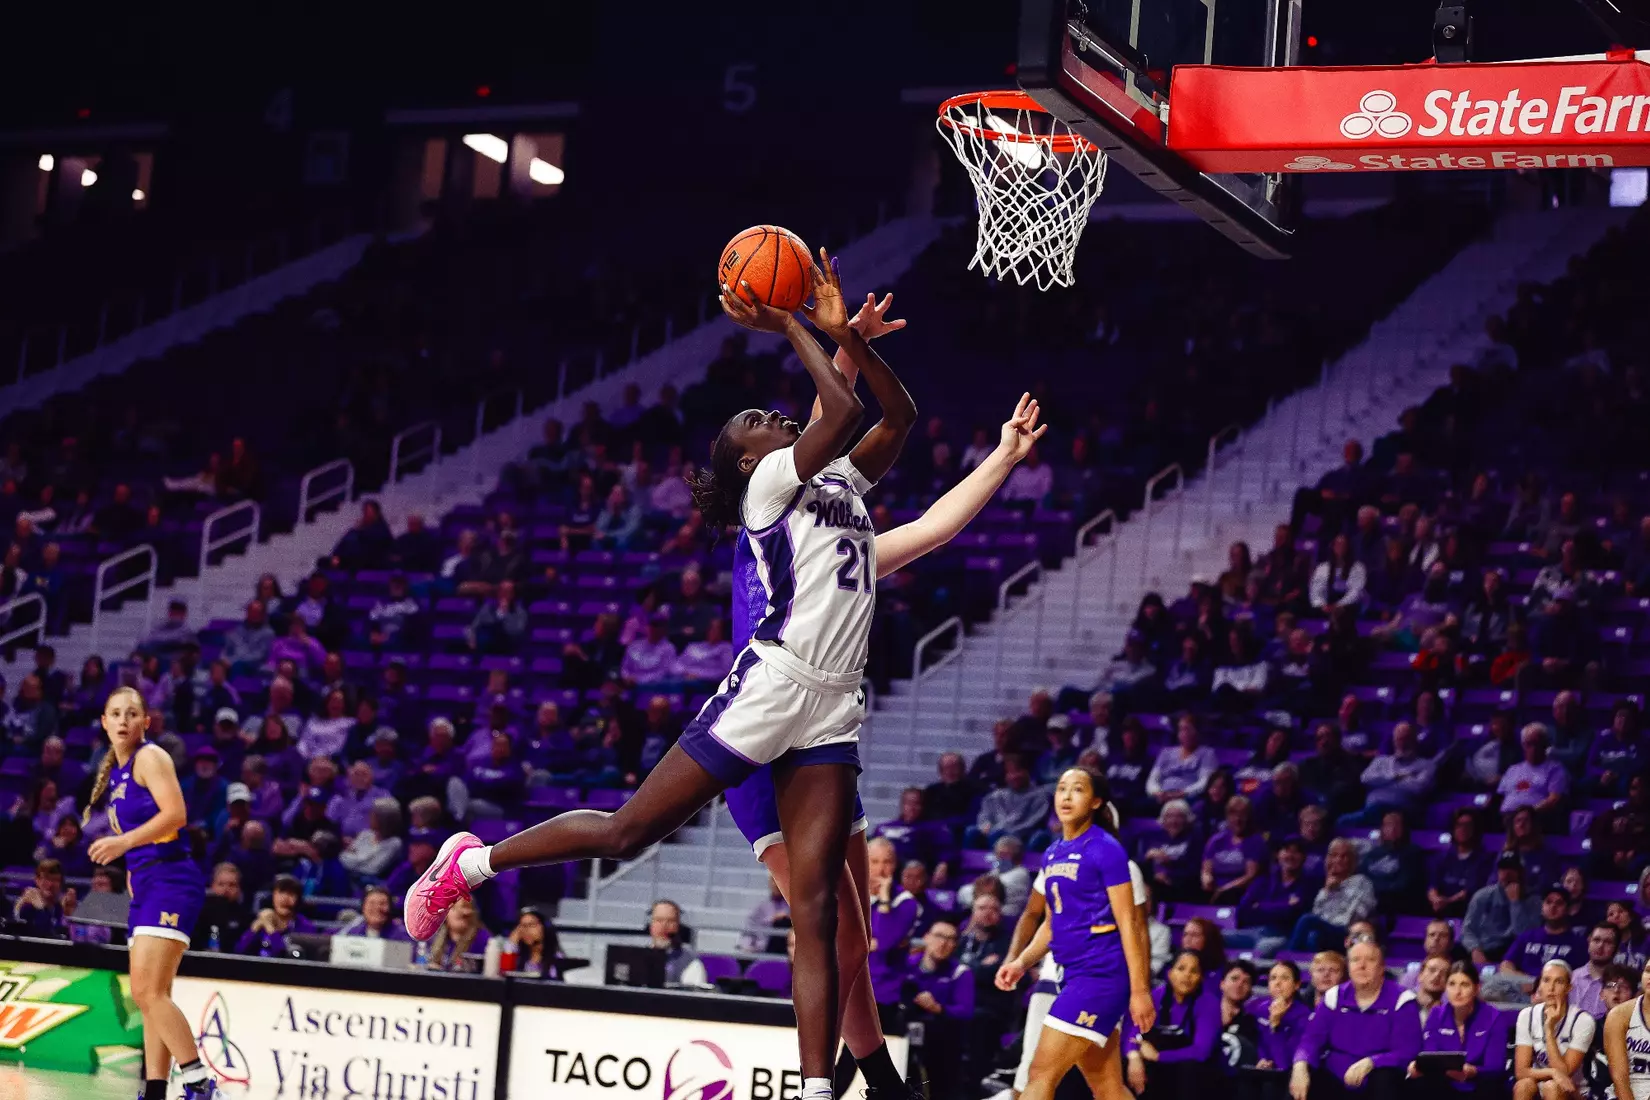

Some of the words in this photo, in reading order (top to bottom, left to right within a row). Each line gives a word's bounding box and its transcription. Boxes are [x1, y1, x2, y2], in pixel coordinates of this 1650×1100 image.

[724, 62, 757, 111] 5
[1417, 88, 1549, 137] State
[1359, 153, 1488, 171] State
[1492, 151, 1615, 170] Farm
[836, 537, 872, 594] 21
[159, 911, 180, 927] M
[1051, 882, 1063, 914] 1
[272, 995, 474, 1049] Ascension
[1075, 1010, 1098, 1028] M
[271, 1049, 330, 1092] Via
[343, 1055, 480, 1100] Christi
[545, 1049, 651, 1091] TACO
[750, 1067, 800, 1100] BE
